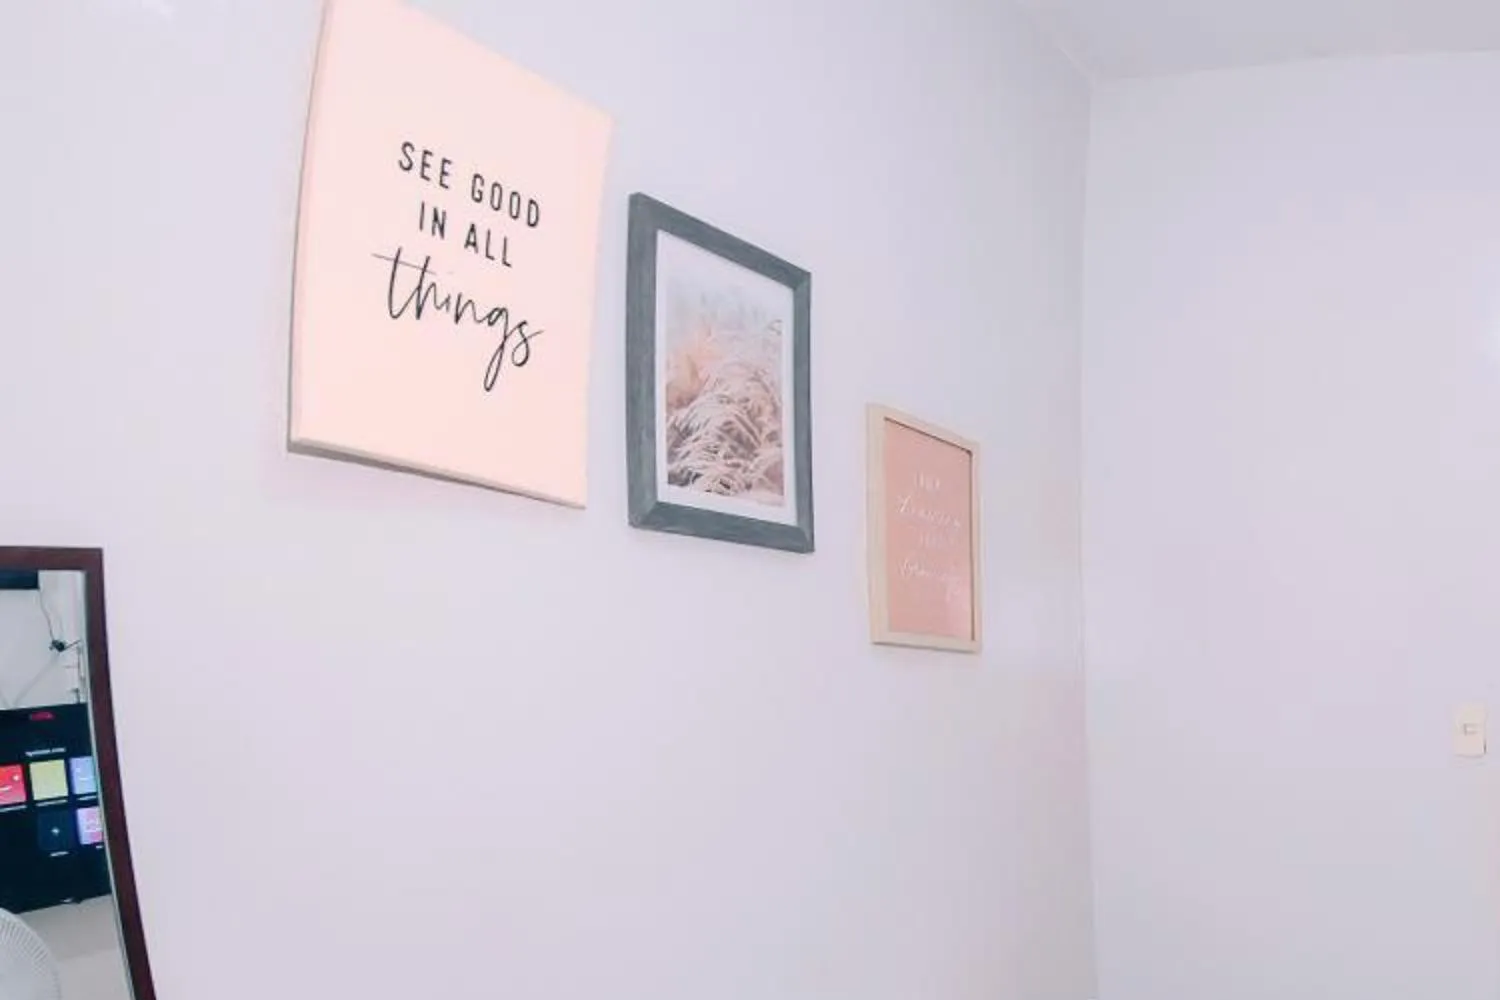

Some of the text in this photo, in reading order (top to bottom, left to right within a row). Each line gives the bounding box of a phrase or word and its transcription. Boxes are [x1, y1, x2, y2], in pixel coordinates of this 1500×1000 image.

[398, 141, 541, 229] SEE GOOD
[418, 200, 513, 269] IN ALL
[371, 246, 545, 393] things
